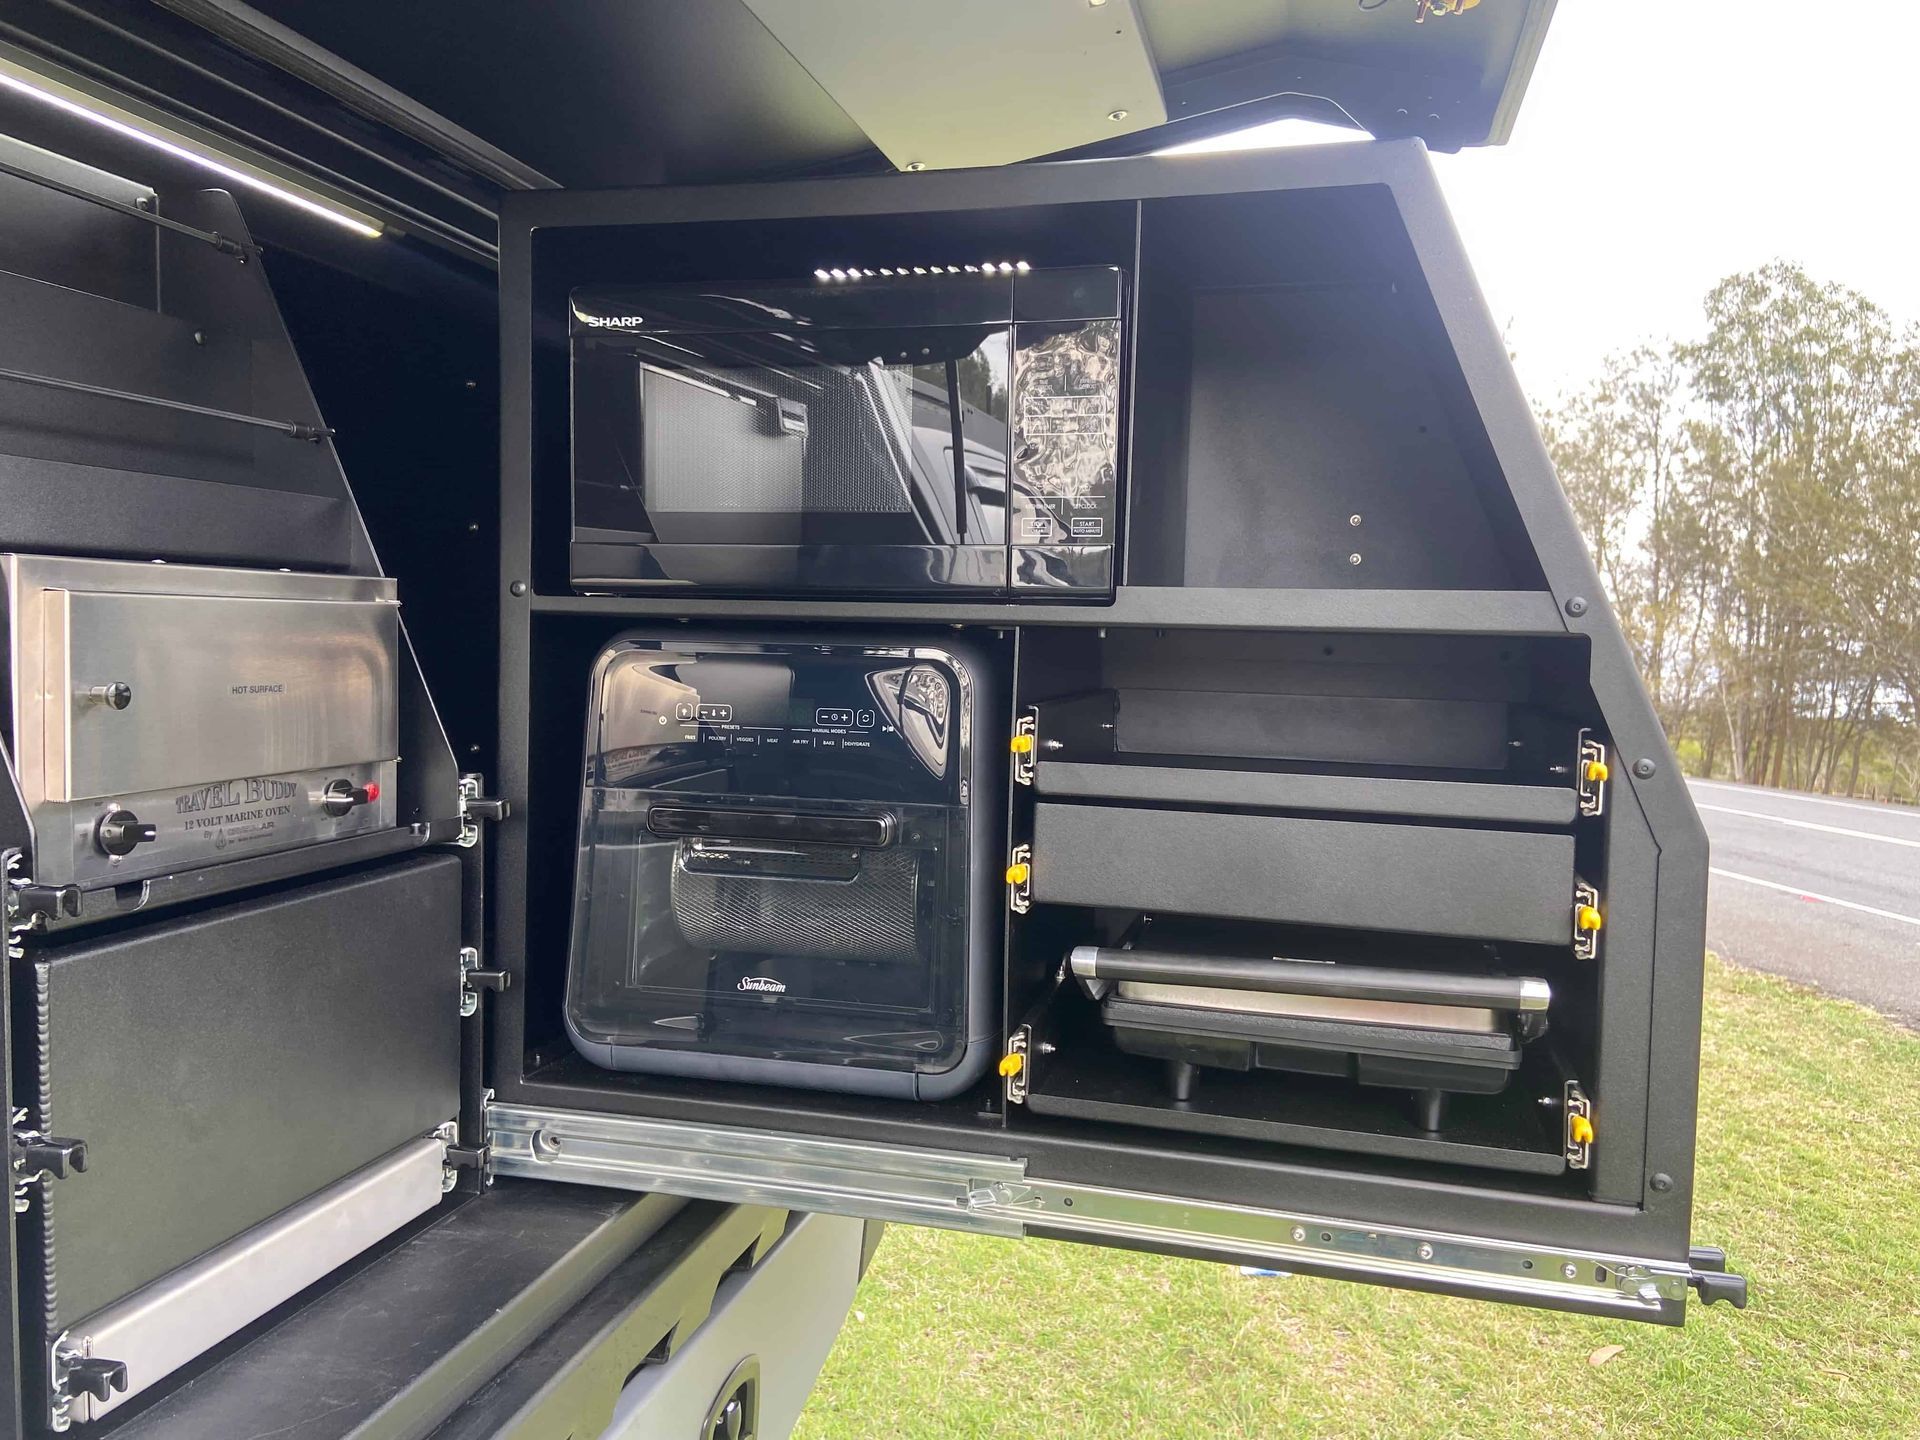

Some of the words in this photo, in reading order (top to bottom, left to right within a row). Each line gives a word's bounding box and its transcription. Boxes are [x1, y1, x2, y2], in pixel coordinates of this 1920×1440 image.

[588, 316, 643, 327] SHARP
[232, 686, 247, 694] HOT
[249, 684, 283, 694] SURFACE
[175, 780, 241, 814] TRAVEL
[184, 820, 195, 830] 12
[196, 816, 224, 829] VOLT
[225, 809, 264, 823] MARINE
[265, 805, 291, 818] OVEN
[737, 976, 786, 993] Sunbeam
